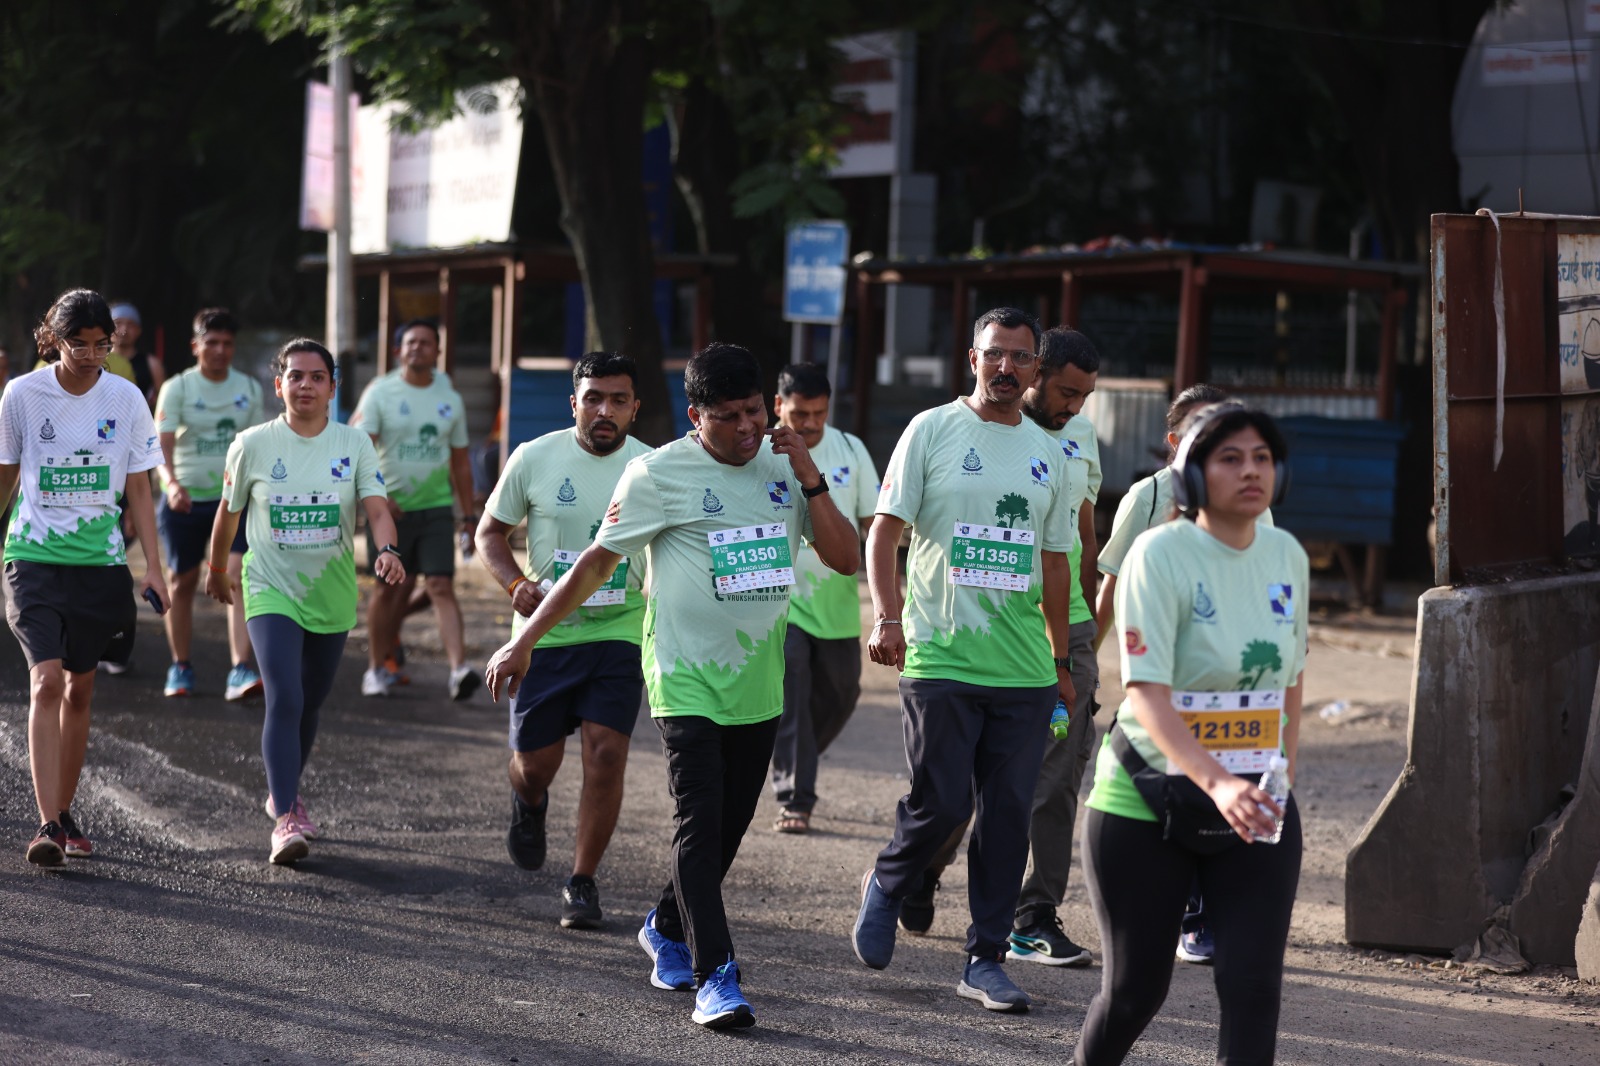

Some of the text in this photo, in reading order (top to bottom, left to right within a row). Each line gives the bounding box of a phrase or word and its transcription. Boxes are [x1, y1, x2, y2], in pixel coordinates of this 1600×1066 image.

[51, 472, 97, 486] 52138
[281, 510, 327, 523] 52172
[726, 546, 777, 566] 51350
[965, 546, 1018, 565] 51356
[735, 565, 758, 573] FRANCIS
[1190, 720, 1261, 740] 12138
